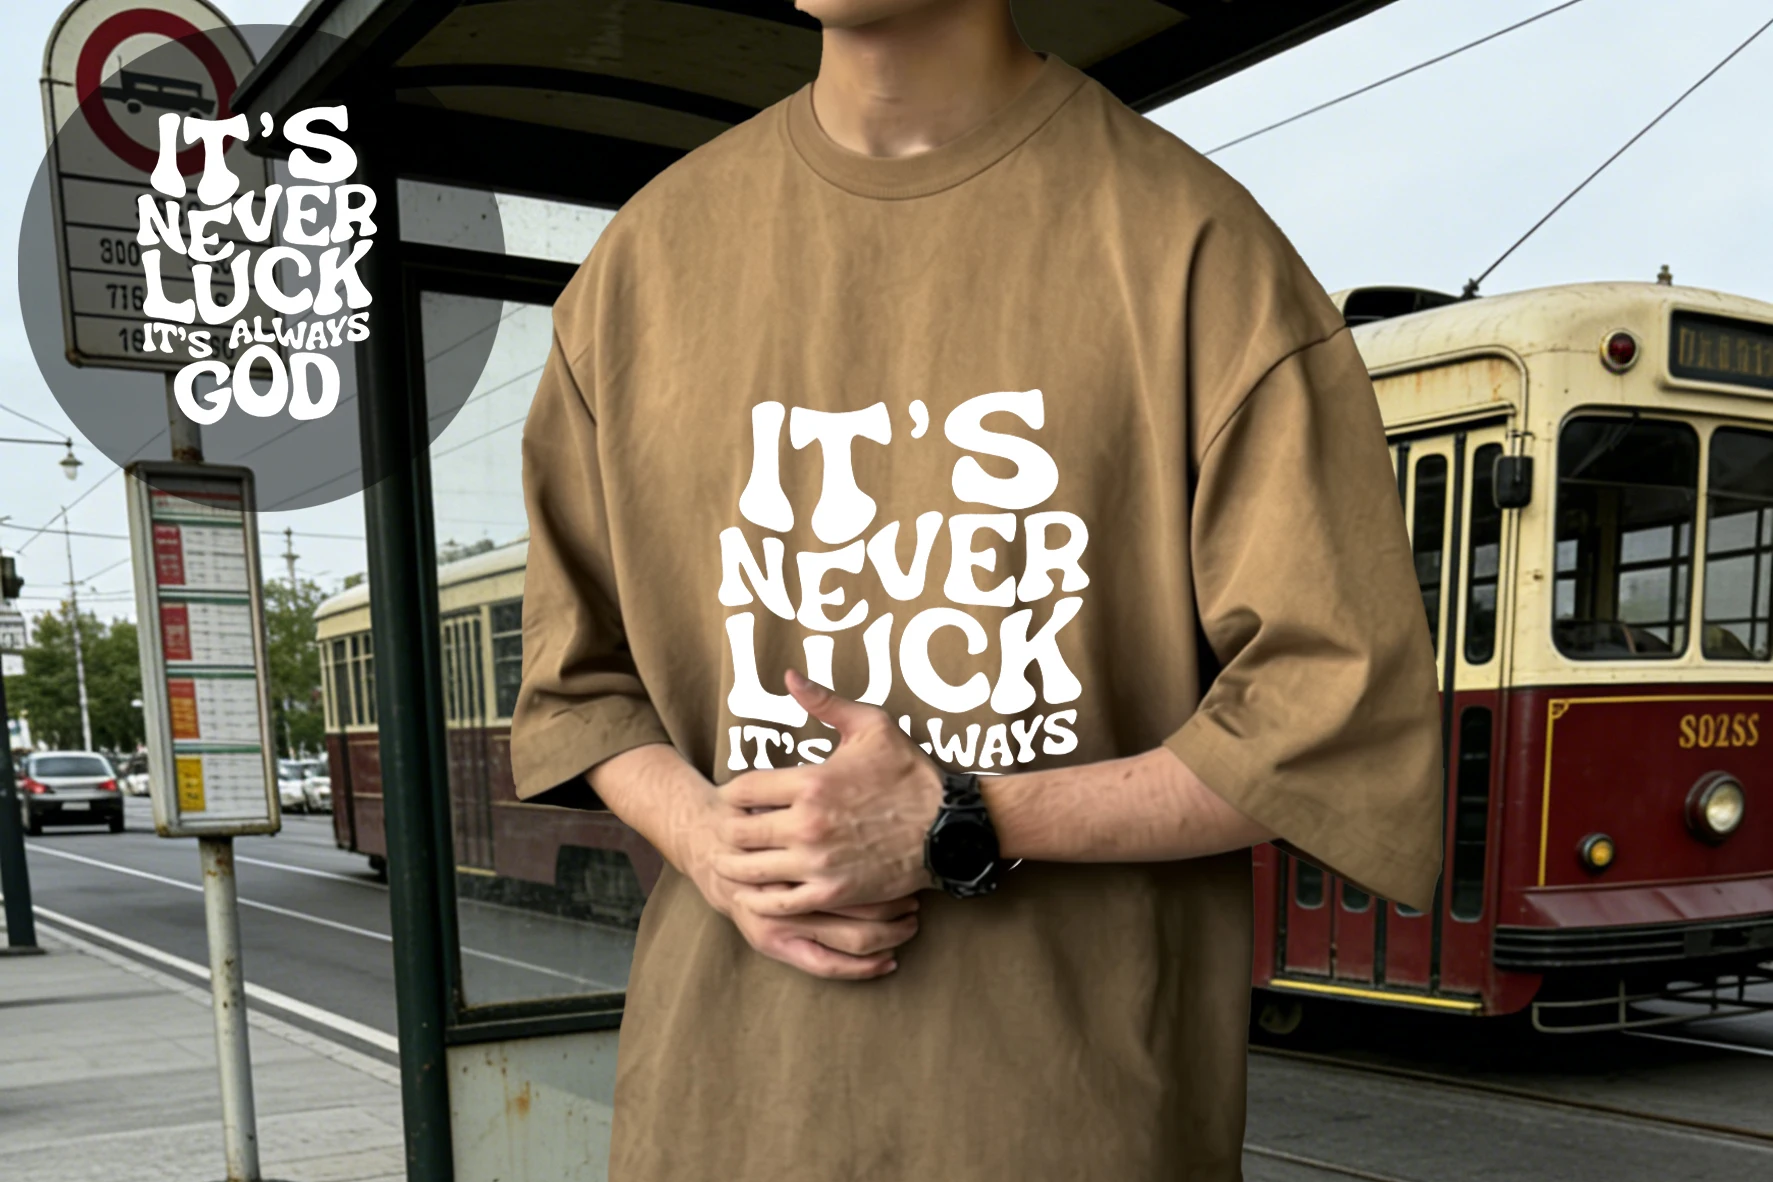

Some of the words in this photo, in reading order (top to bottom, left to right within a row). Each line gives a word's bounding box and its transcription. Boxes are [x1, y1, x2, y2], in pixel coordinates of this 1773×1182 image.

[739, 389, 1060, 544] IT'S
[718, 511, 1090, 632] NEVER
[726, 597, 1083, 728] LUCK
